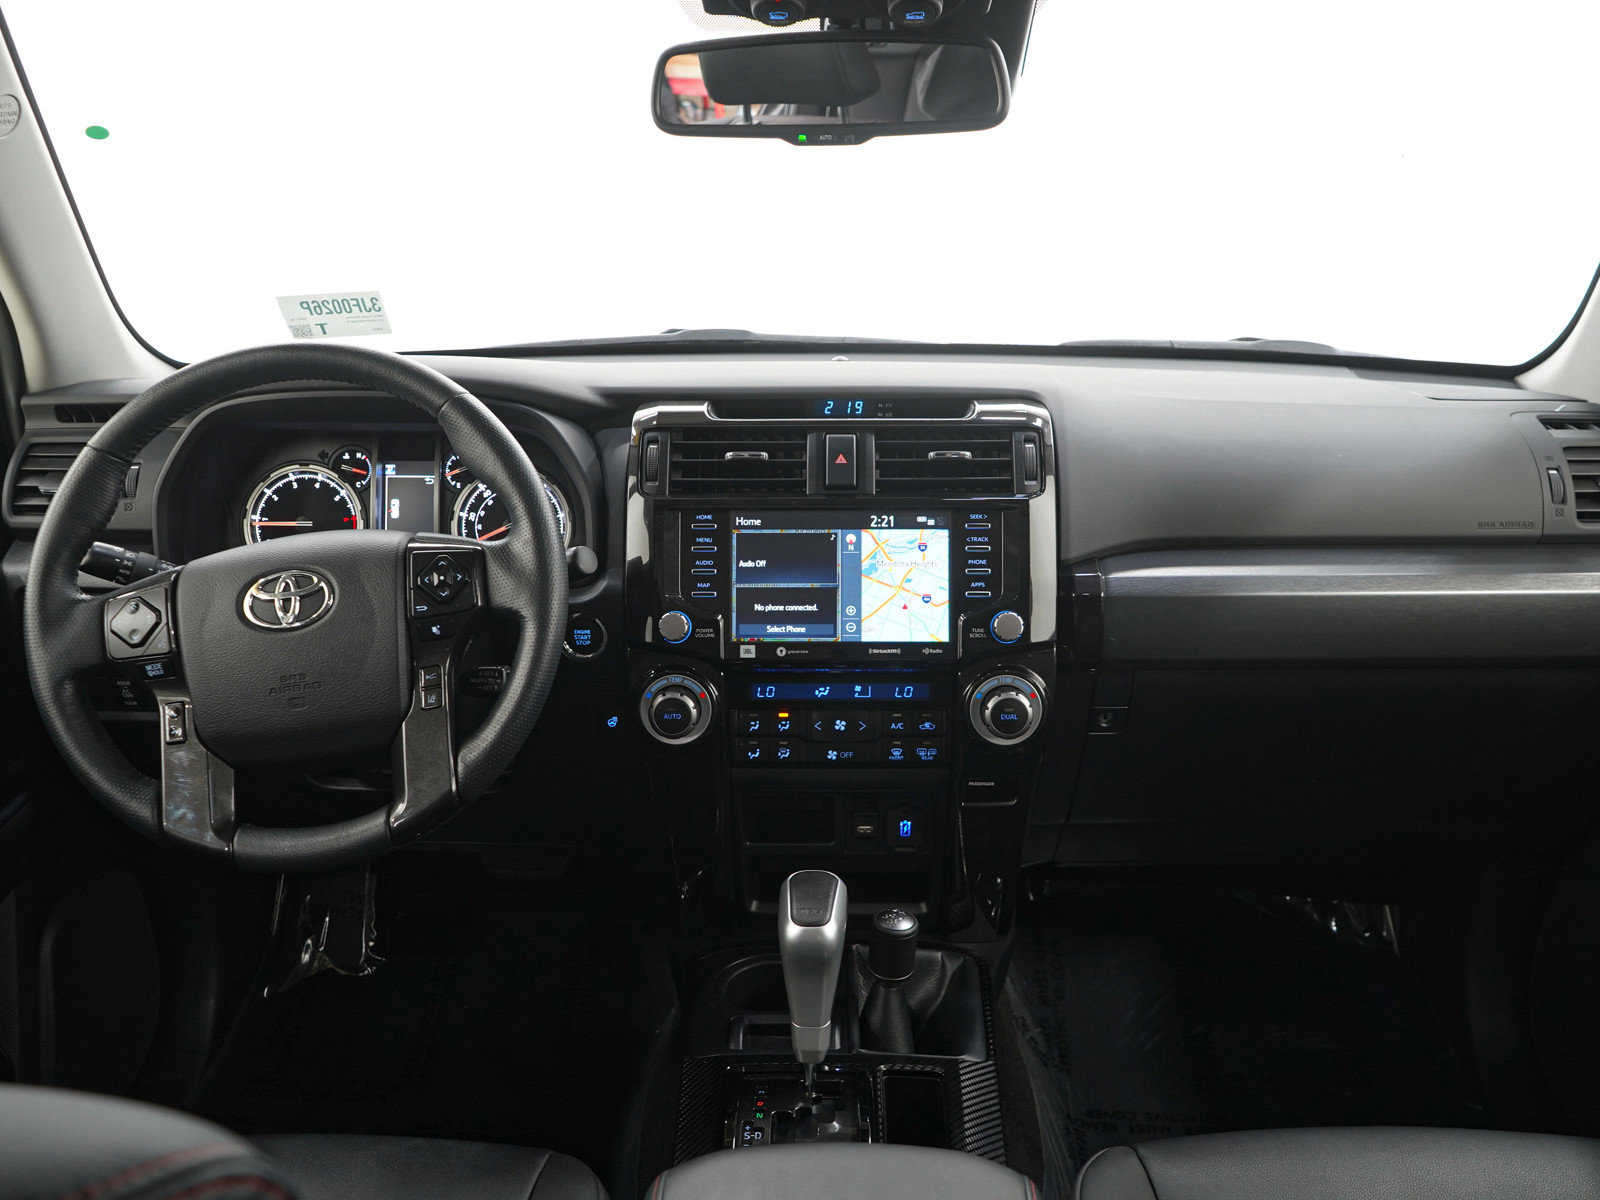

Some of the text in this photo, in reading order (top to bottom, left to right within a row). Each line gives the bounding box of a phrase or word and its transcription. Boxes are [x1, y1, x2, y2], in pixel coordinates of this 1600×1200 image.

[292, 481, 299, 490] 3
[314, 482, 321, 490] 4
[271, 494, 279, 502] 2
[736, 516, 762, 526] Home
[870, 515, 895, 528] 2:21
[738, 559, 767, 567] Audio Off
[910, 560, 938, 569] Heights
[754, 603, 819, 613] No phone connected.
[767, 624, 806, 633] Select Phone
[144, 662, 163, 670] MODE
[756, 686, 776, 698] LO
[894, 685, 914, 698] LO
[890, 722, 905, 730] A/C
